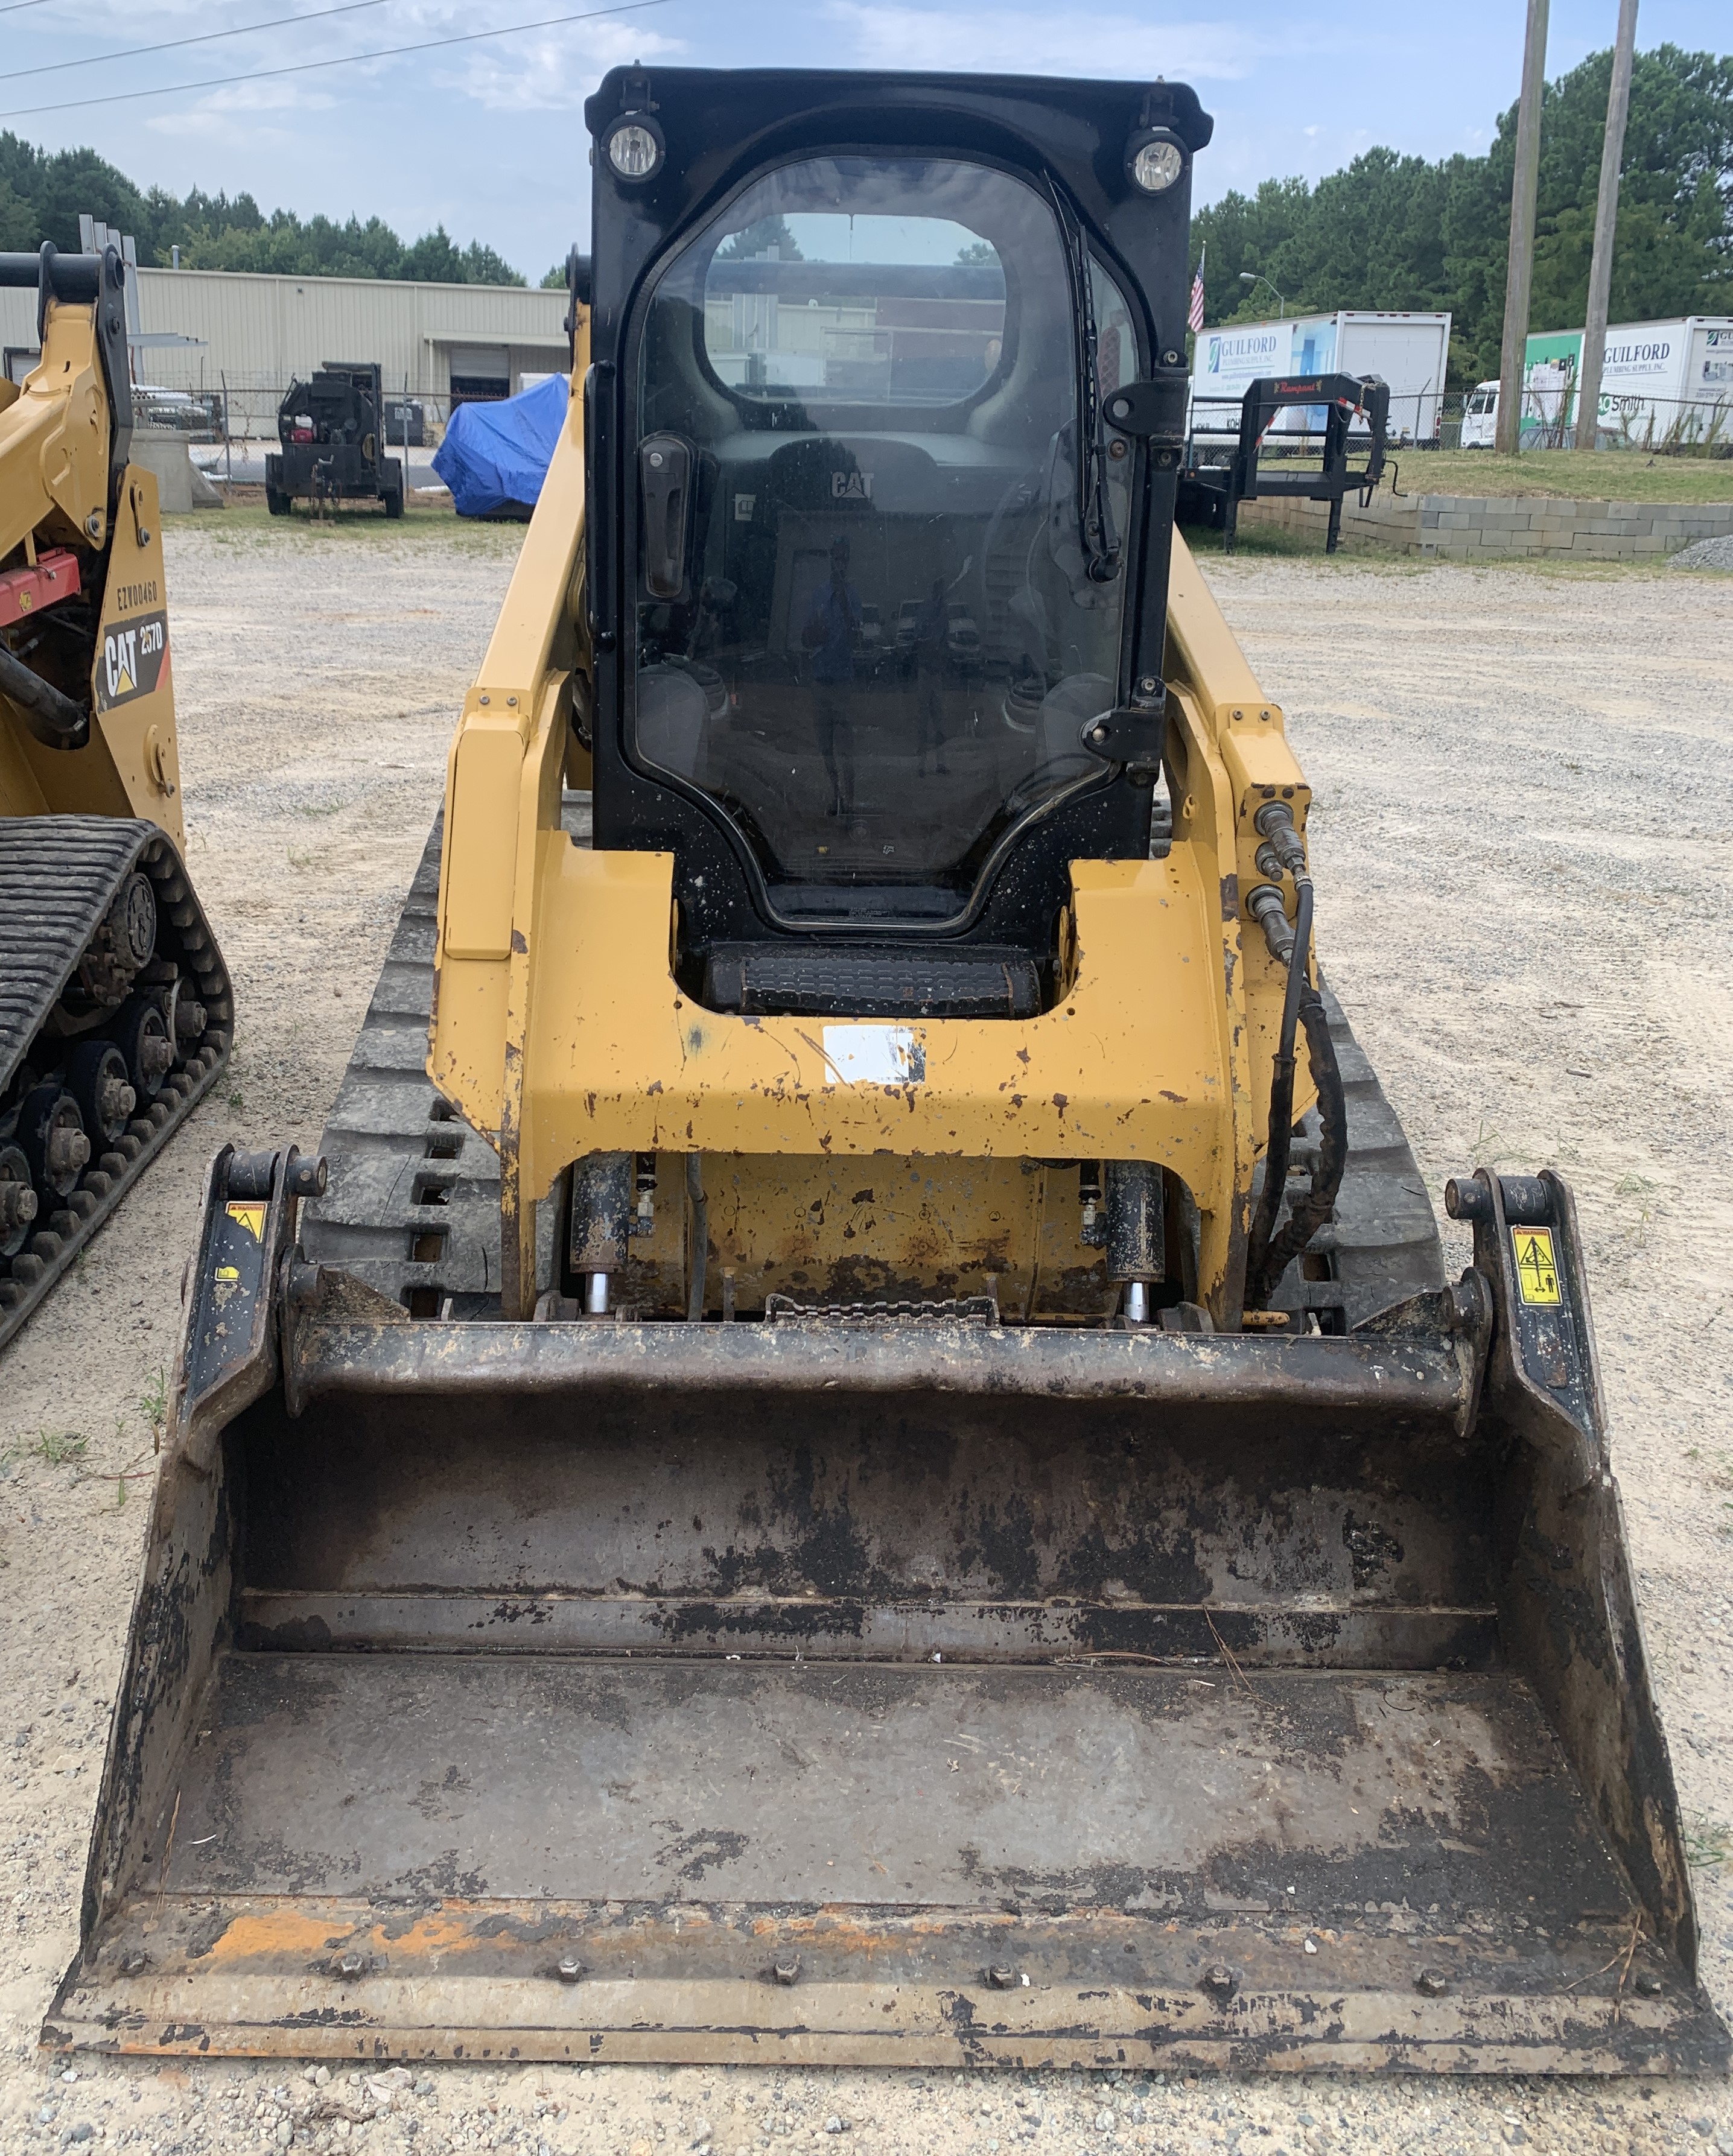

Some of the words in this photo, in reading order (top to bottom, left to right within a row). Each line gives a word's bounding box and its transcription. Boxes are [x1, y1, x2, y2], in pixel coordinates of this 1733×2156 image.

[1222, 336, 1276, 357] GUILFORD
[1604, 343, 1670, 363] GUILFORD
[1603, 365, 1631, 374] PLUMBING
[1279, 381, 1315, 394] Rampant
[1227, 417, 1242, 430] KOH
[832, 472, 875, 498] CAT
[117, 580, 157, 611] EZW00460
[104, 629, 138, 697] CAT
[139, 621, 163, 655] 257D
